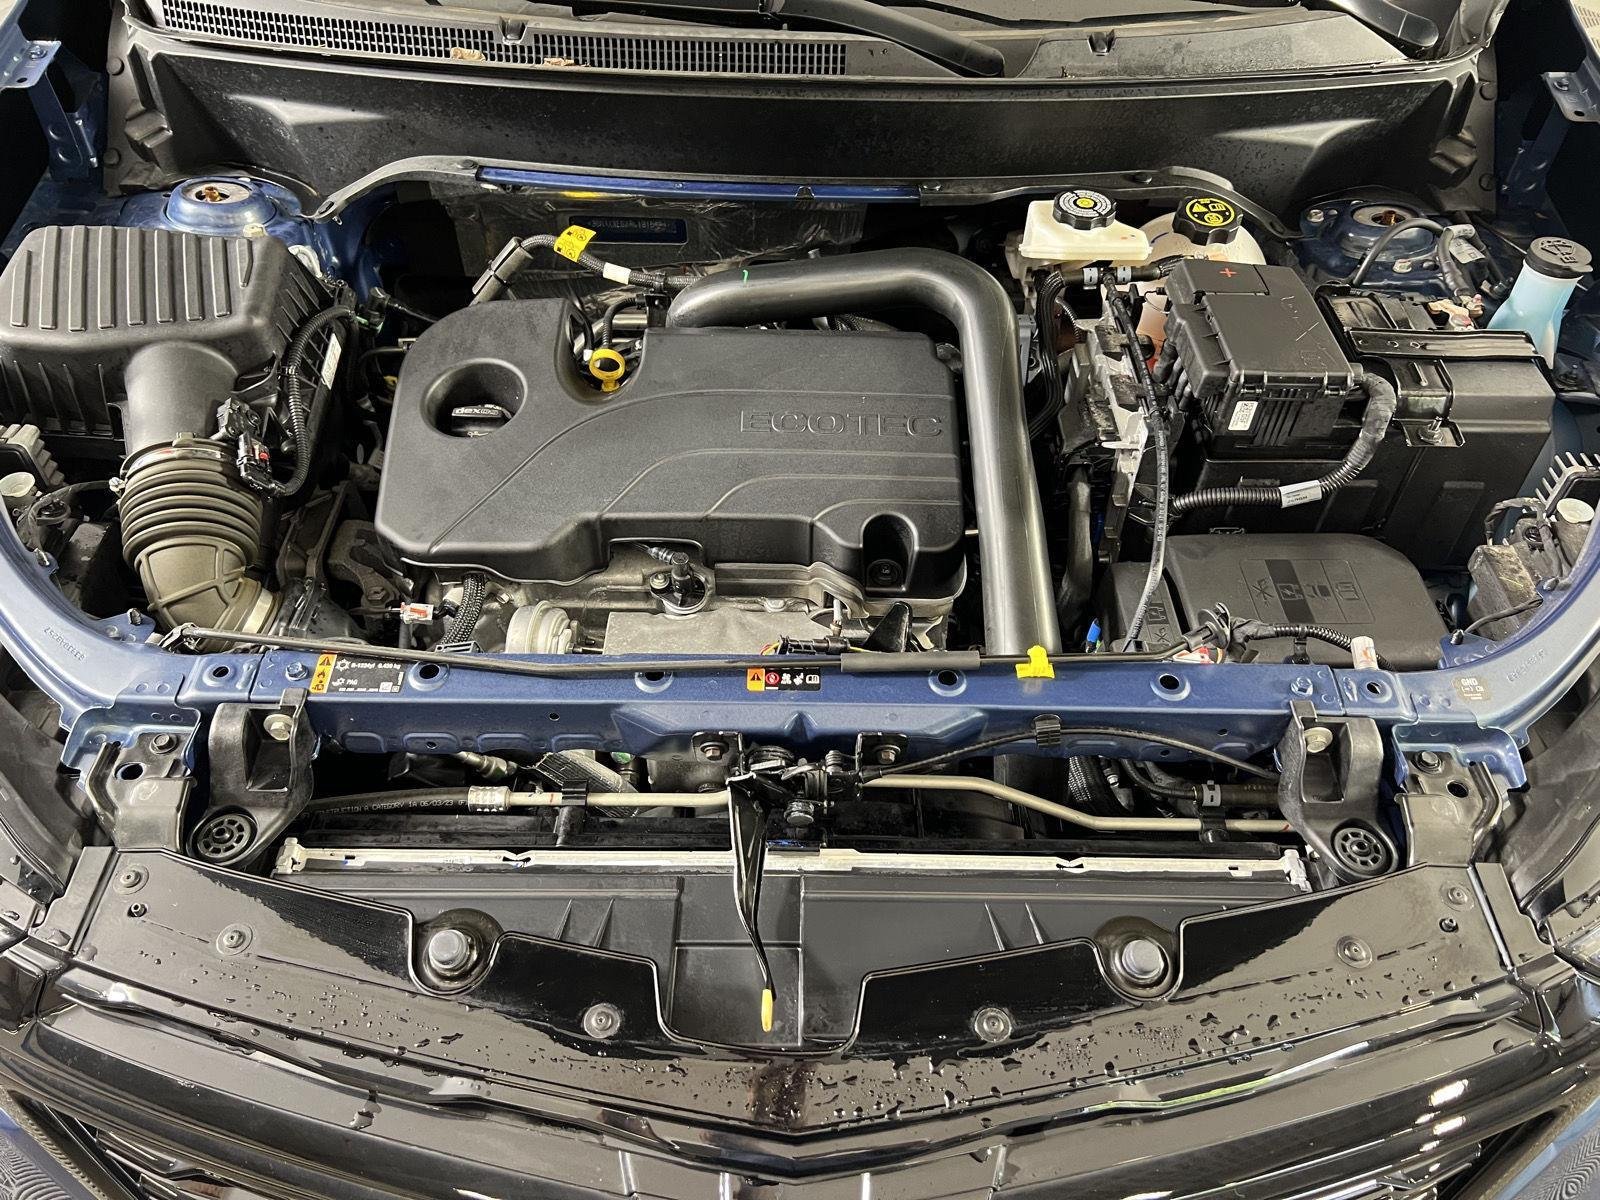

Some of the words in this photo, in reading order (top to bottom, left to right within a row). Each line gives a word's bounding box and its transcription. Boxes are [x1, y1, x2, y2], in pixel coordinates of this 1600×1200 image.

[740, 409, 942, 436] ECOTEC
[372, 801, 405, 810] CATEGORY
[420, 799, 454, 807] 06/03/23
